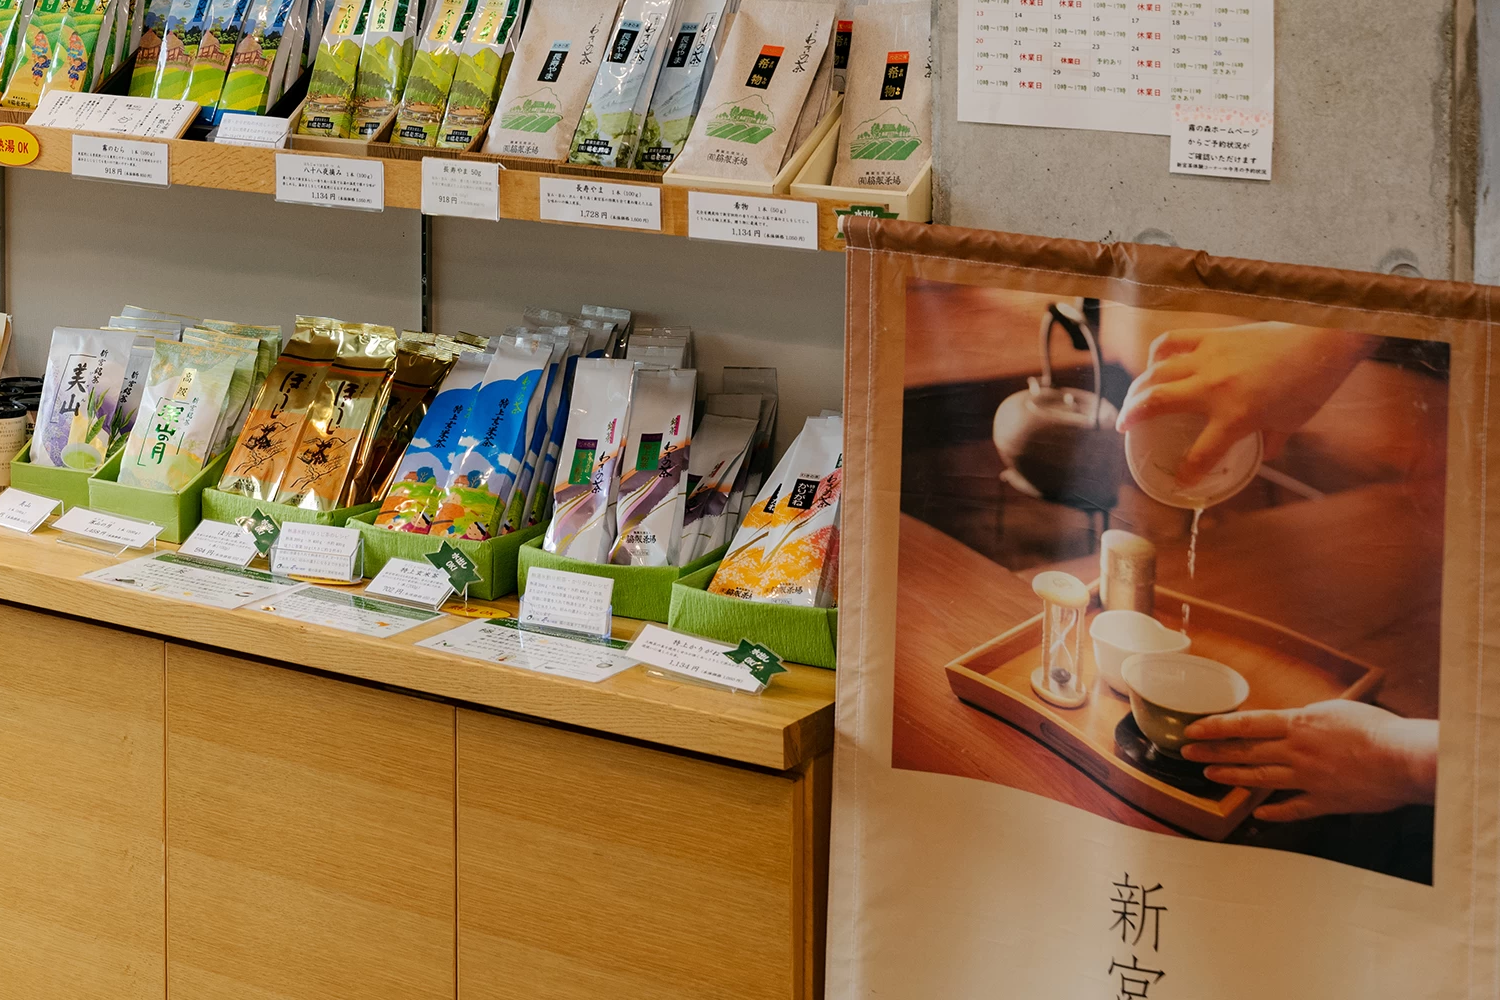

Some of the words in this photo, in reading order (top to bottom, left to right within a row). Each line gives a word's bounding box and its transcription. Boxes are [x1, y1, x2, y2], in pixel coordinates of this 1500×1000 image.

[1059, 0, 1082, 8] 休業日
[1137, 3, 1161, 12] 休業日
[1137, 32, 1161, 40] 休業日
[613, 32, 632, 60] 長寿やま
[673, 35, 690, 64] 長寿やま
[543, 52, 562, 80] 長寿やま
[751, 57, 770, 86] 希物
[884, 66, 899, 97] 希物
[1188, 124, 1259, 136] 霧の森ホームページ
[17, 142, 29, 154] OK
[102, 144, 125, 154] 霧のむら
[1188, 139, 1250, 149] からご予約状況が
[1188, 152, 1257, 164] ご確認いただけます
[104, 167, 123, 175] 918円
[303, 166, 342, 177] 八十八夜摘み
[443, 166, 469, 175] 長寿やま
[471, 168, 482, 177] 50g
[311, 192, 336, 201] 1,134円
[576, 184, 603, 194] 長寿やま
[438, 195, 457, 205] 918円
[733, 201, 749, 211] 希物
[580, 210, 608, 220] 1,728円
[732, 228, 761, 238] 1,134円
[91, 349, 109, 384] 新宮銘茶
[59, 363, 88, 417] 美山
[120, 371, 140, 403] 新宮銘茶
[175, 372, 193, 397] 高級
[244, 371, 307, 450] ほうじ茶
[299, 381, 360, 466] ほうじ茶
[434, 404, 464, 449] 特上玄米茶
[481, 398, 510, 448] 特上玄米茶
[151, 404, 184, 464] 深山の月
[659, 441, 677, 478] わきの茶
[591, 451, 611, 494] わきの茶
[791, 482, 807, 507] かりがね
[451, 552, 469, 569] 水出し
[400, 565, 441, 579] 特上玄米茶
[673, 640, 720, 657] 特上かりがね
[752, 649, 769, 662] 水出し
[668, 659, 700, 673] 1,134円
[1108, 871, 1168, 1000] 新宮
